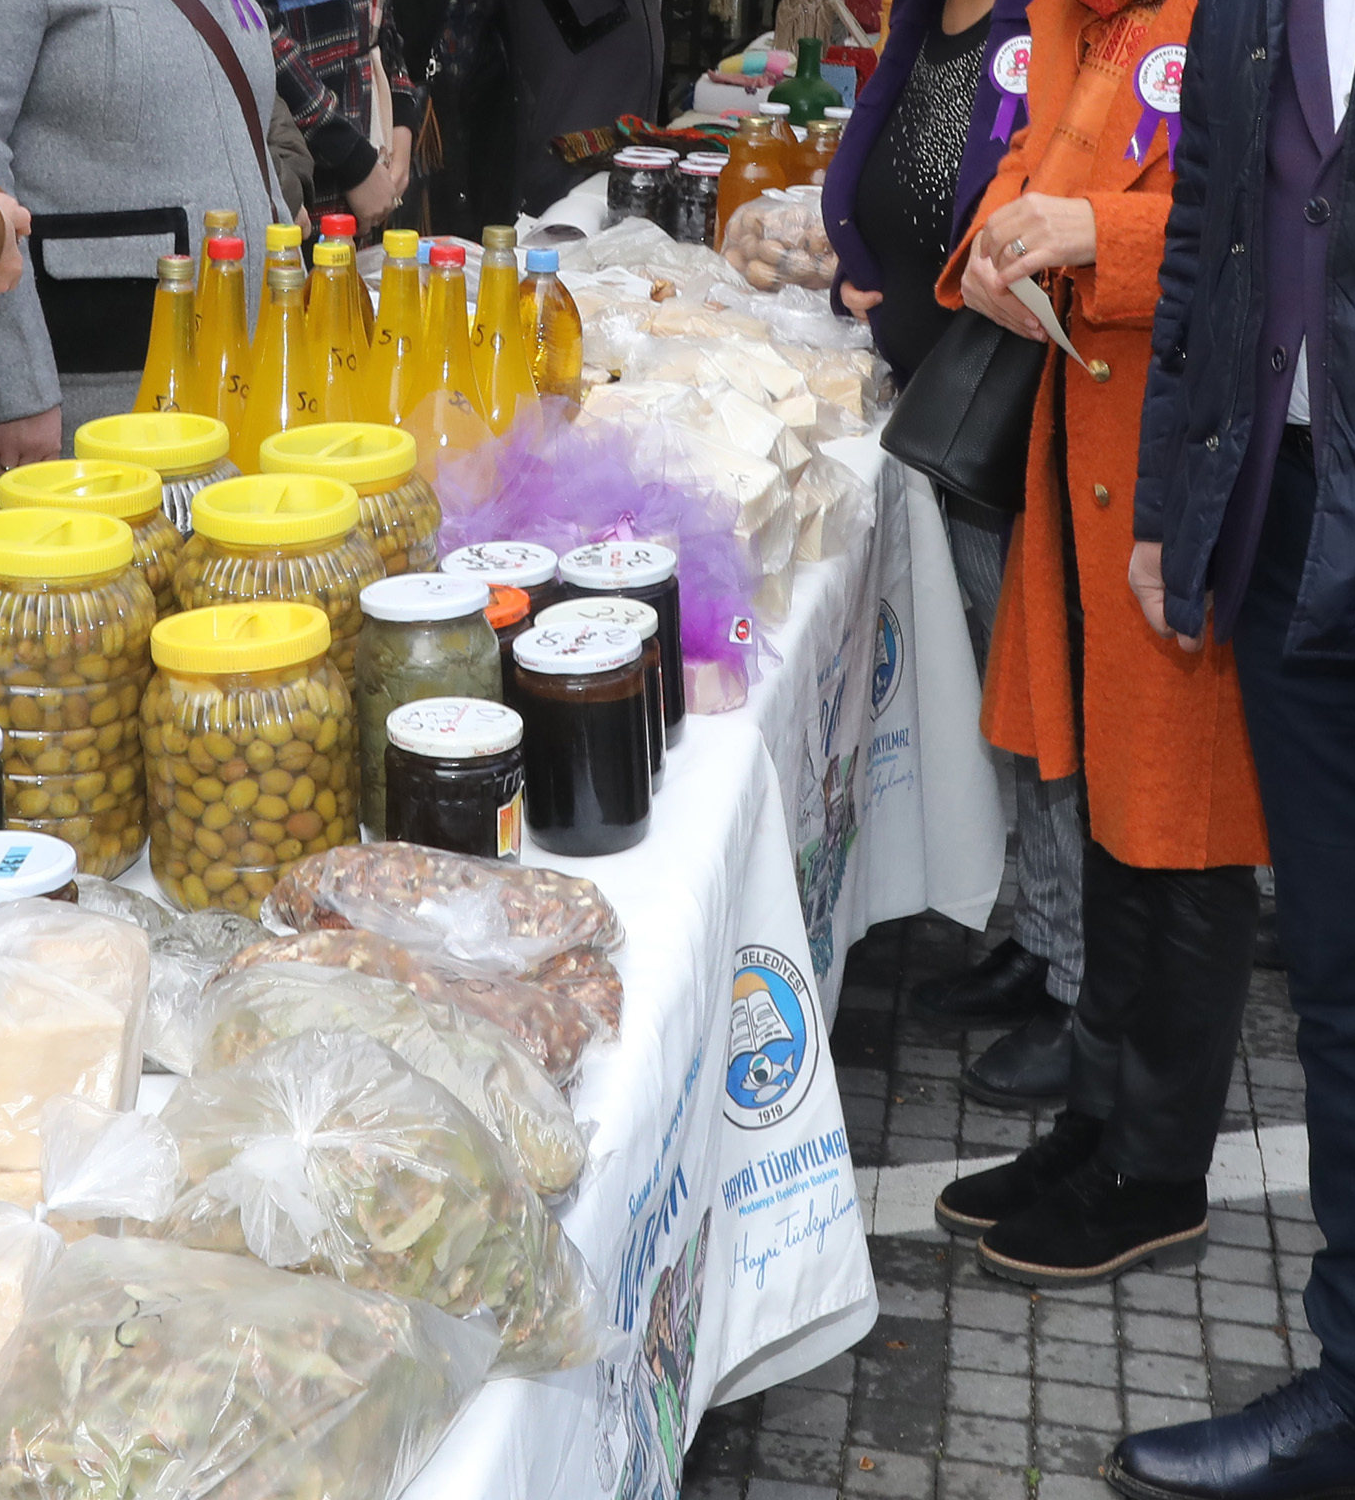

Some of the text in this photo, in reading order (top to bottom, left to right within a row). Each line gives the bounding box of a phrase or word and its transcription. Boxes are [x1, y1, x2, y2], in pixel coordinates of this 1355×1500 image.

[378, 329, 412, 353] 50
[473, 323, 506, 350] 50
[297, 391, 318, 413] 50
[449, 390, 473, 415] 50
[741, 950, 806, 996] BELEDİYESİ
[757, 1103, 784, 1124] 1919
[721, 1160, 759, 1212] HAYRİ
[738, 1167, 840, 1219] Mudanya Belediye Başkanı
[729, 1231, 782, 1291] Hayri
